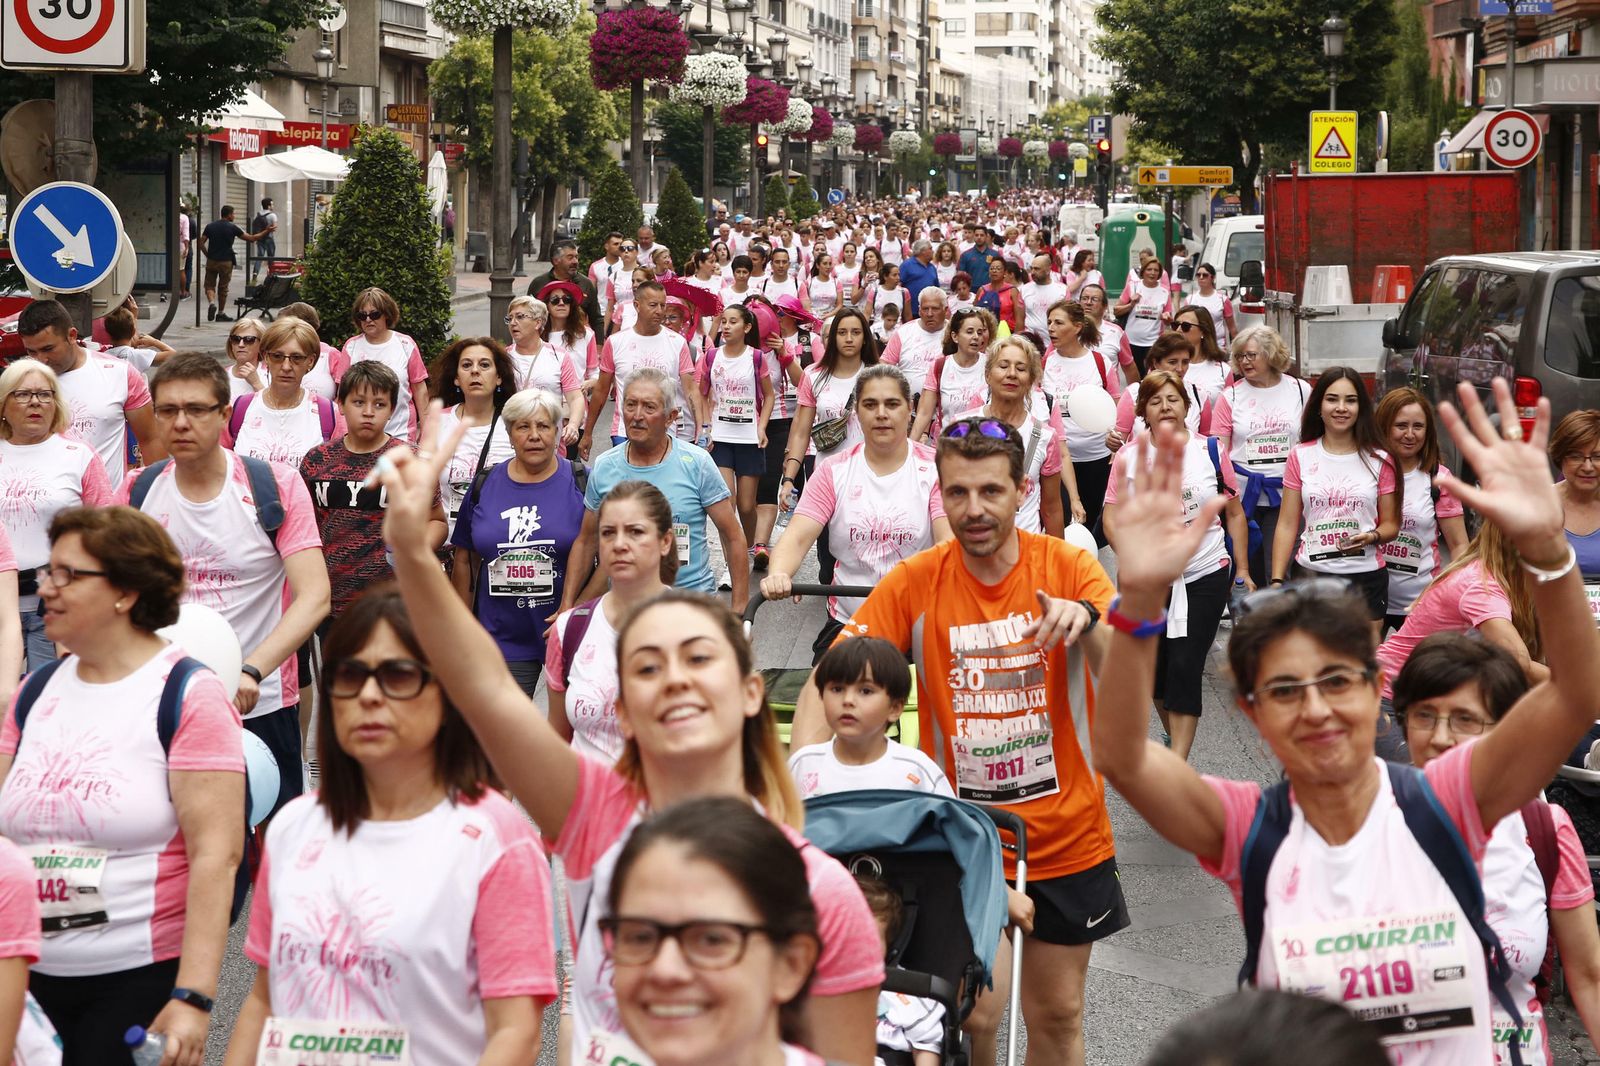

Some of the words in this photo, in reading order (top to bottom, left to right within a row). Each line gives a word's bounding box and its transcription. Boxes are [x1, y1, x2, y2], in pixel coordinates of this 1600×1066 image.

[39, 0, 92, 20] 30
[1508, 4, 1541, 13] OTEL
[1314, 115, 1355, 124] ATENCIÓN
[276, 126, 340, 142] telepizza
[1496, 129, 1528, 148] 30
[229, 127, 260, 158] telepizza
[1199, 168, 1230, 176] Comfort
[1314, 161, 1352, 169] COLEGIO
[1257, 445, 1279, 455] 4035
[850, 527, 866, 542] Por
[1380, 544, 1408, 559] 3959
[506, 565, 536, 579] 7505
[948, 668, 986, 691] 30
[574, 698, 596, 719] Por
[984, 755, 1025, 781] 7817
[996, 781, 1019, 791] ROBERT
[1389, 912, 1457, 928] Fundación
[1339, 960, 1415, 1001] 2119
